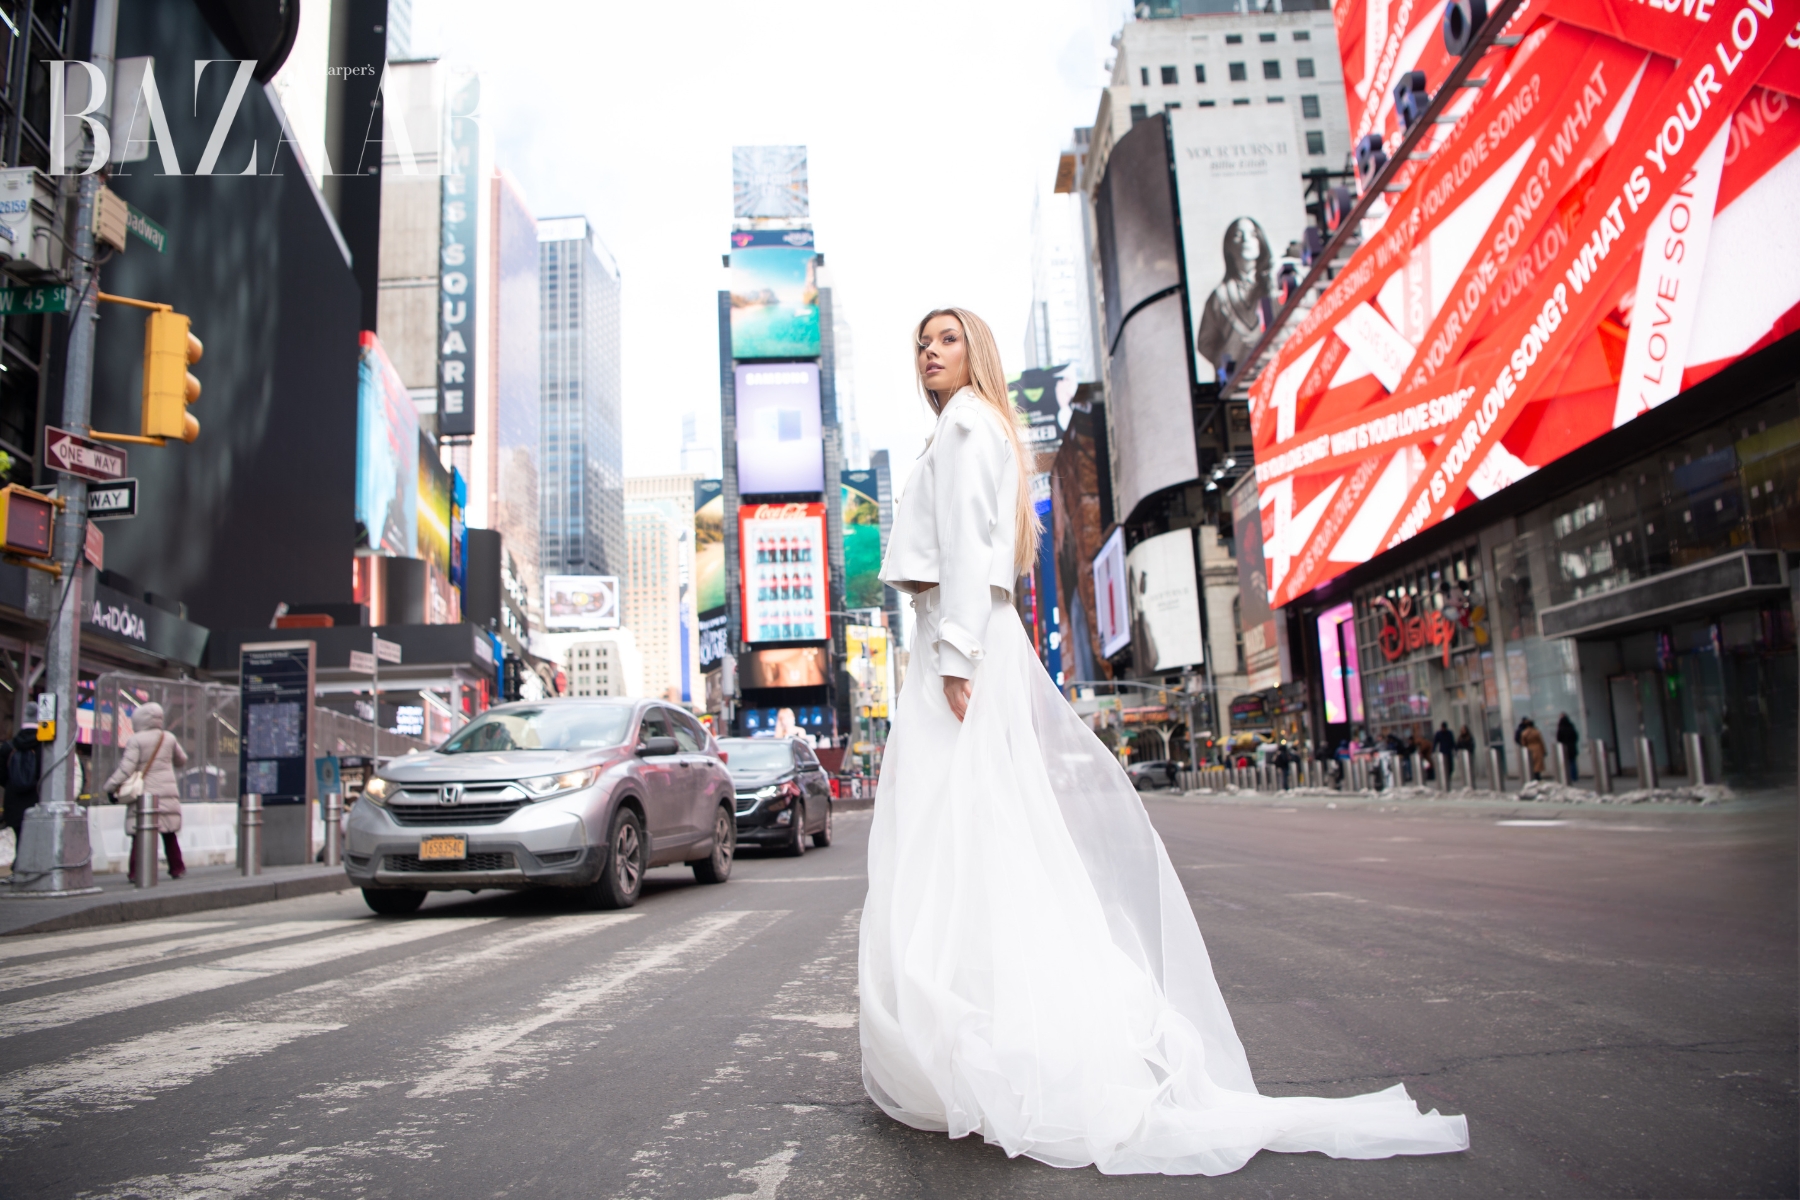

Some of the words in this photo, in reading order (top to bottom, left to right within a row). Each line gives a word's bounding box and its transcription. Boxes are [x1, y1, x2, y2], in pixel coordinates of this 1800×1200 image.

[1421, 170, 1456, 221] YOUR
[1452, 131, 1490, 188] LOVE
[1487, 73, 1542, 150] SONG?
[1724, 87, 1790, 167] ONG
[126, 209, 165, 253] oadway
[1422, 309, 1463, 378] YOUR
[1457, 249, 1499, 325] LOVE
[1493, 157, 1552, 265] SONG?
[1548, 60, 1608, 169] WHAT
[23, 288, 45, 311] 45
[53, 287, 66, 301] St
[1429, 470, 1447, 504] IS
[1441, 418, 1481, 484] YOUR
[1475, 364, 1517, 436] LOVE
[1511, 282, 1569, 382] SONG?
[1565, 195, 1626, 294] WHAT
[1622, 164, 1651, 214] IS
[1645, 63, 1723, 174] YOUR
[1643, 273, 1680, 386] LOVE
[1664, 168, 1698, 265] SON
[442, 242, 469, 416] SQUARE
[745, 371, 809, 386] SAMSUNG
[60, 443, 83, 464] ONE
[94, 453, 116, 472] WAY
[1330, 427, 1358, 457] WHAT
[1367, 413, 1400, 446] YOUR
[1397, 402, 1430, 438] LOVE
[90, 492, 121, 508] WAY
